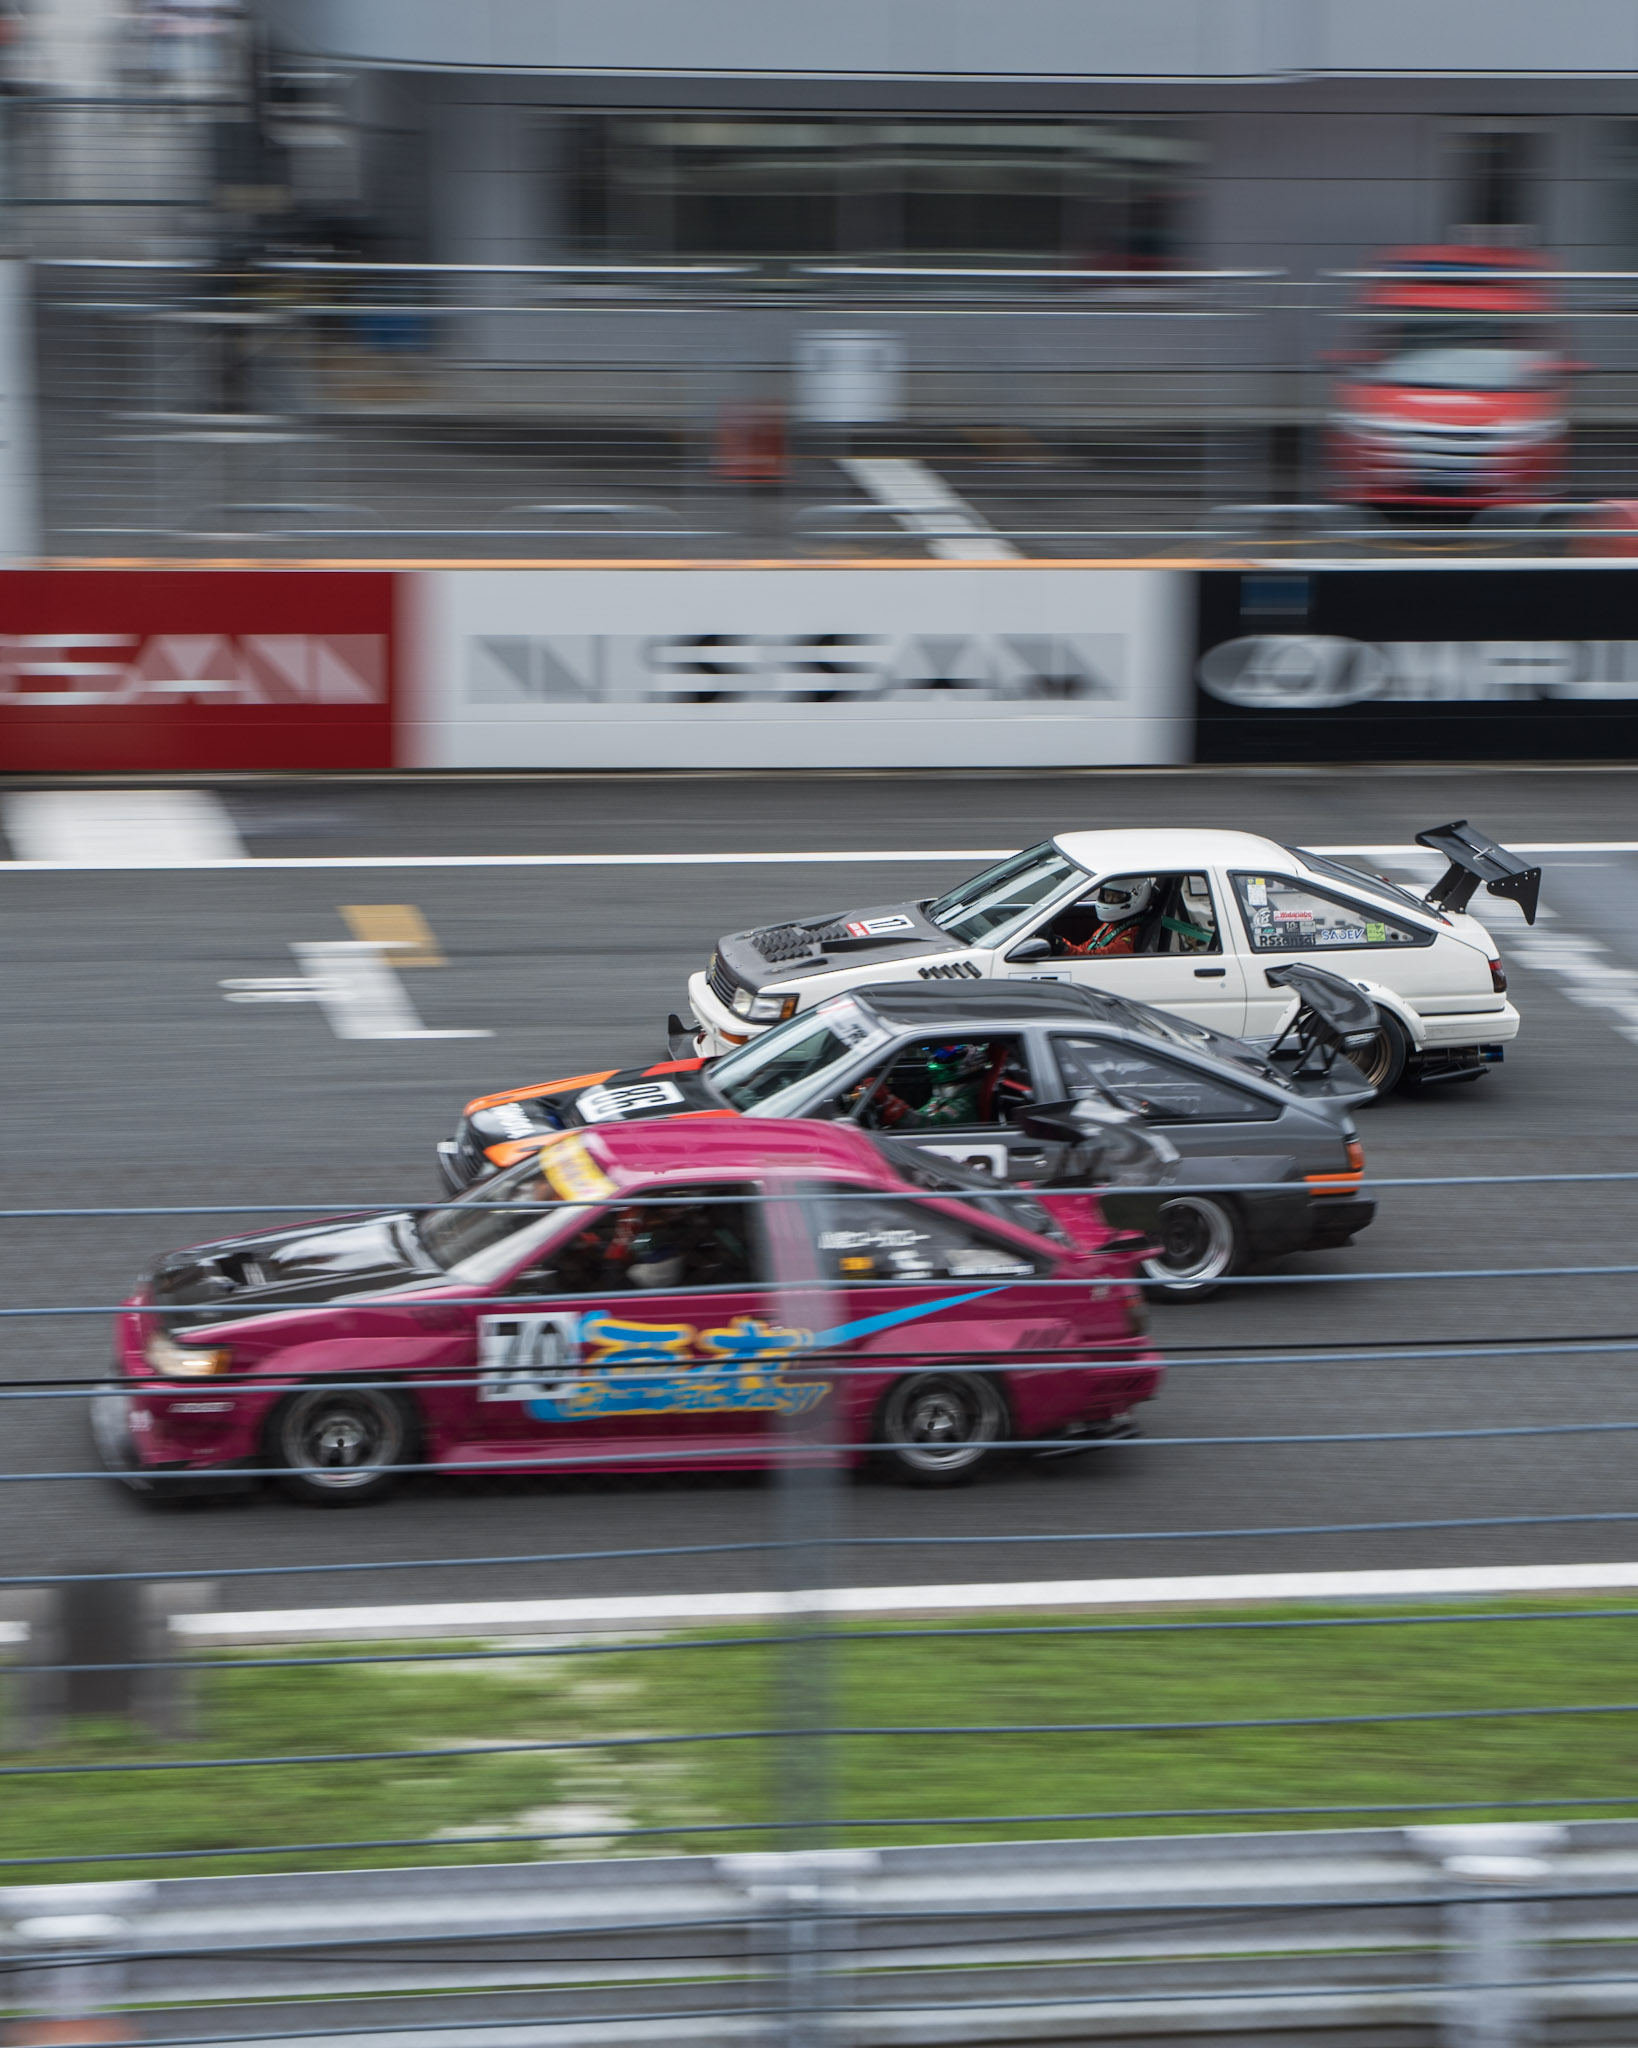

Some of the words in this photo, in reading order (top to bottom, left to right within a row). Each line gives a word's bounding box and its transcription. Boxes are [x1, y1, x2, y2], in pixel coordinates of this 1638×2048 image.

[0, 634, 387, 703] SAN
[465, 633, 1127, 703] NISSAN
[488, 1321, 572, 1394] 70
